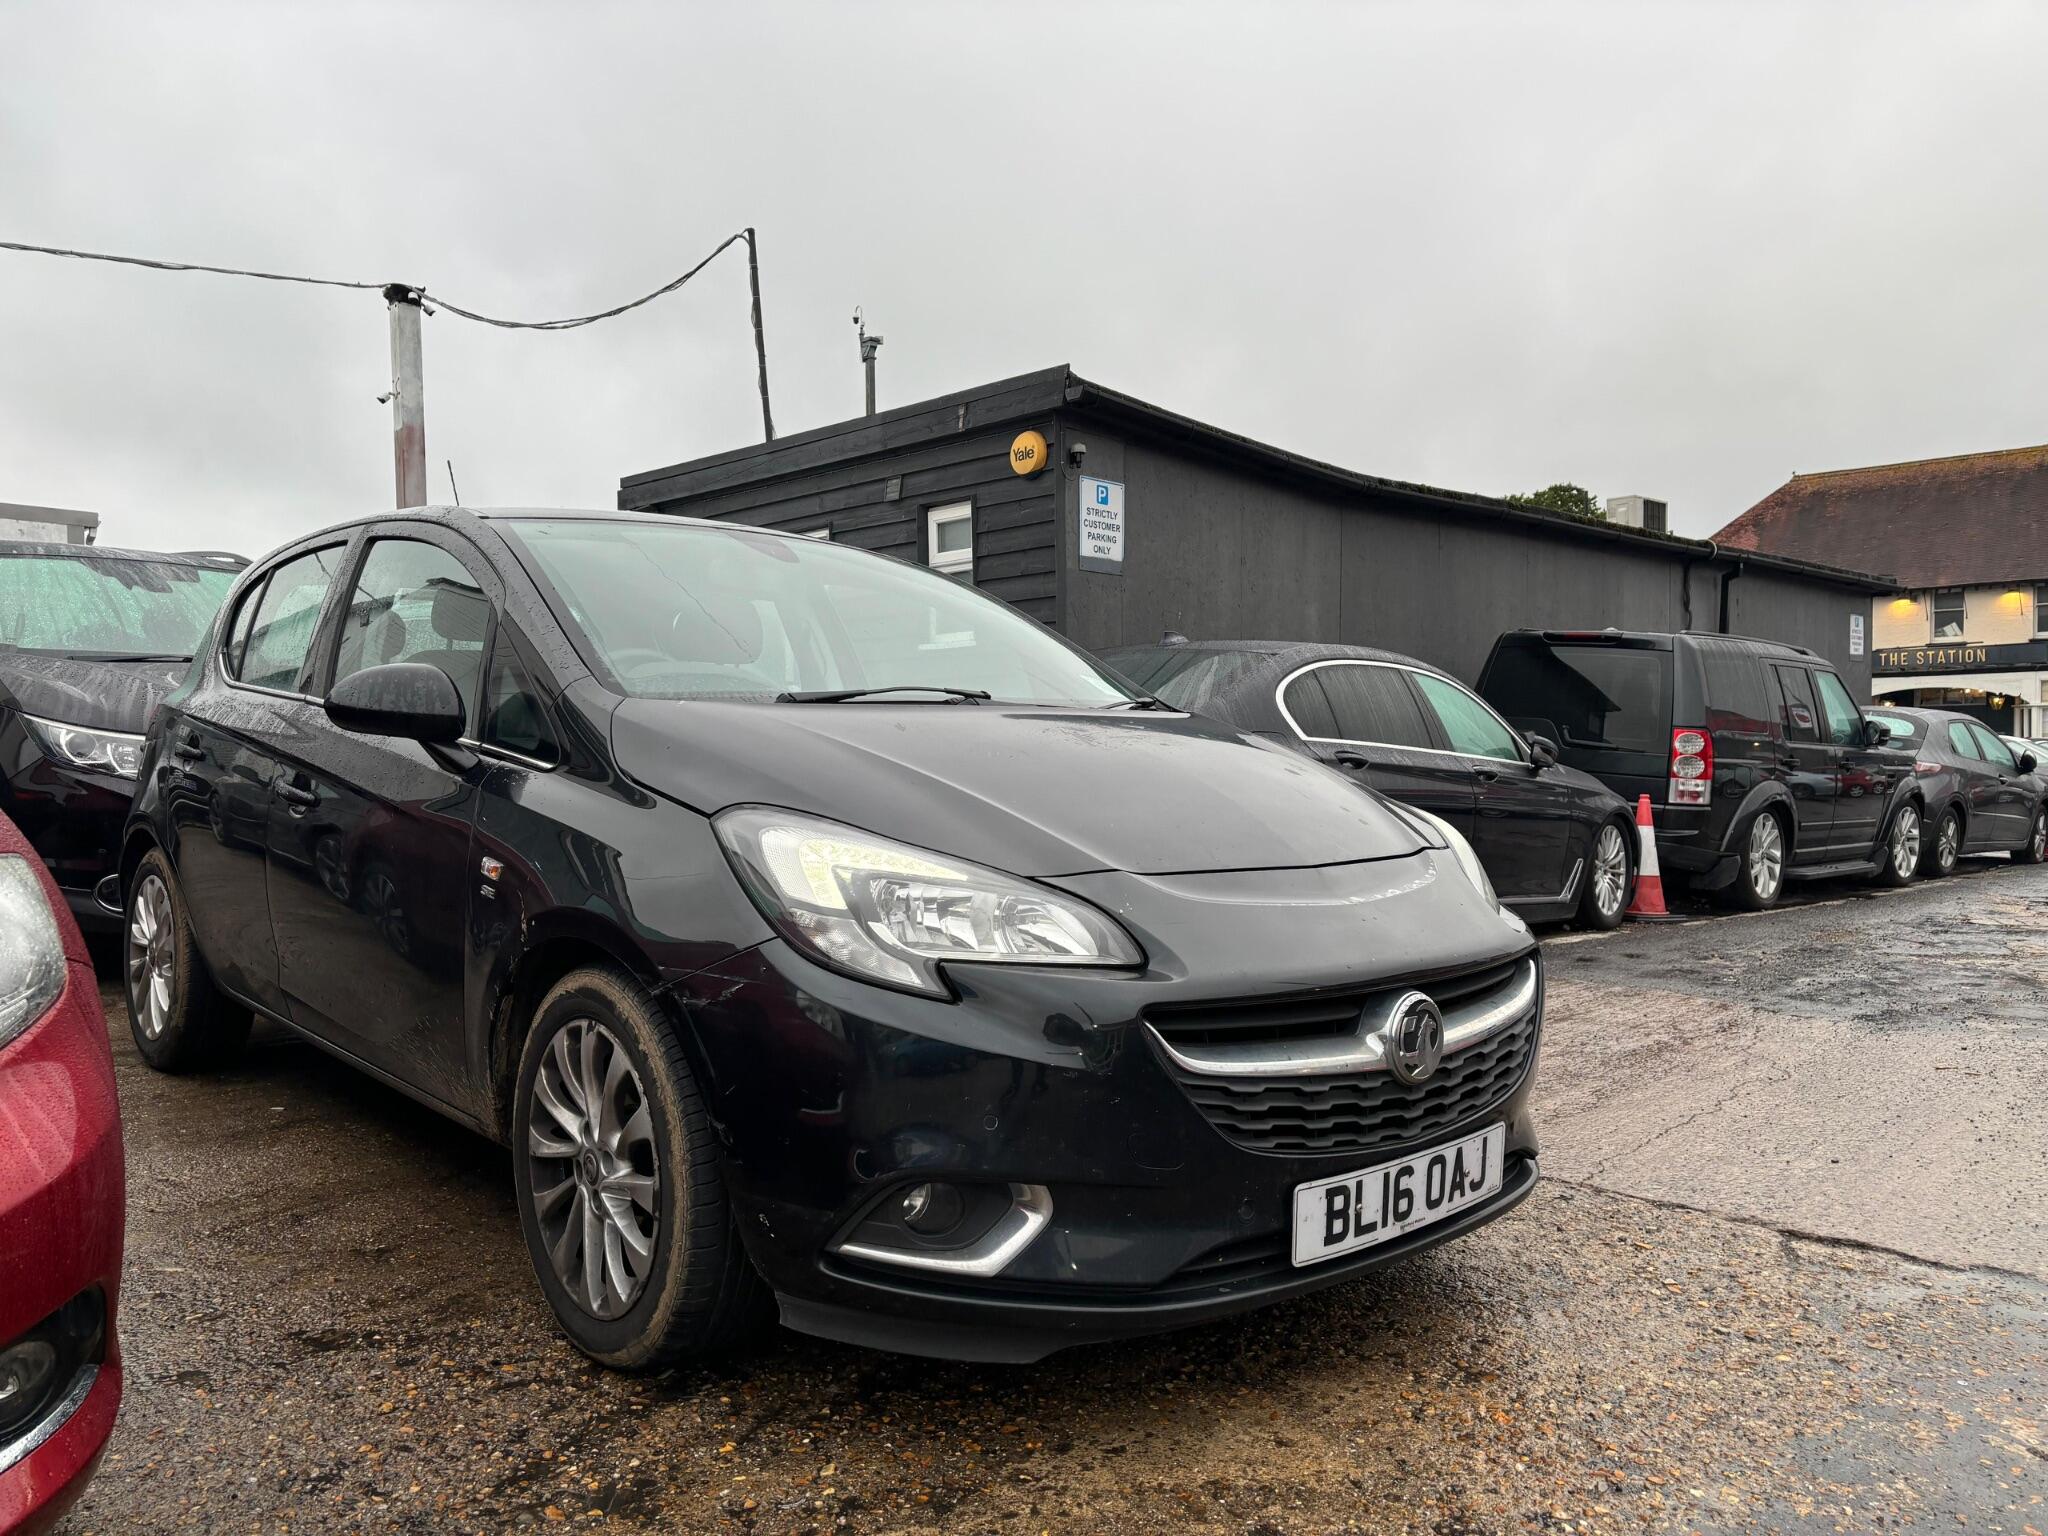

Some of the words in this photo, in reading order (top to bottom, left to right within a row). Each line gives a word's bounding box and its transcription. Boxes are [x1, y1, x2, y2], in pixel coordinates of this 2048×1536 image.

[1013, 446, 1035, 462] Yale
[1098, 486, 1107, 503] P
[1086, 507, 1118, 520] STRICTLY
[1083, 518, 1121, 533] CUSTOMER
[1087, 531, 1117, 544] PARKING
[1093, 545, 1111, 555] ONLY
[1879, 652, 1909, 666] THE
[1916, 648, 1987, 665] STATION
[1324, 1165, 1415, 1246] BL16
[1425, 1136, 1488, 1210] OAJ
